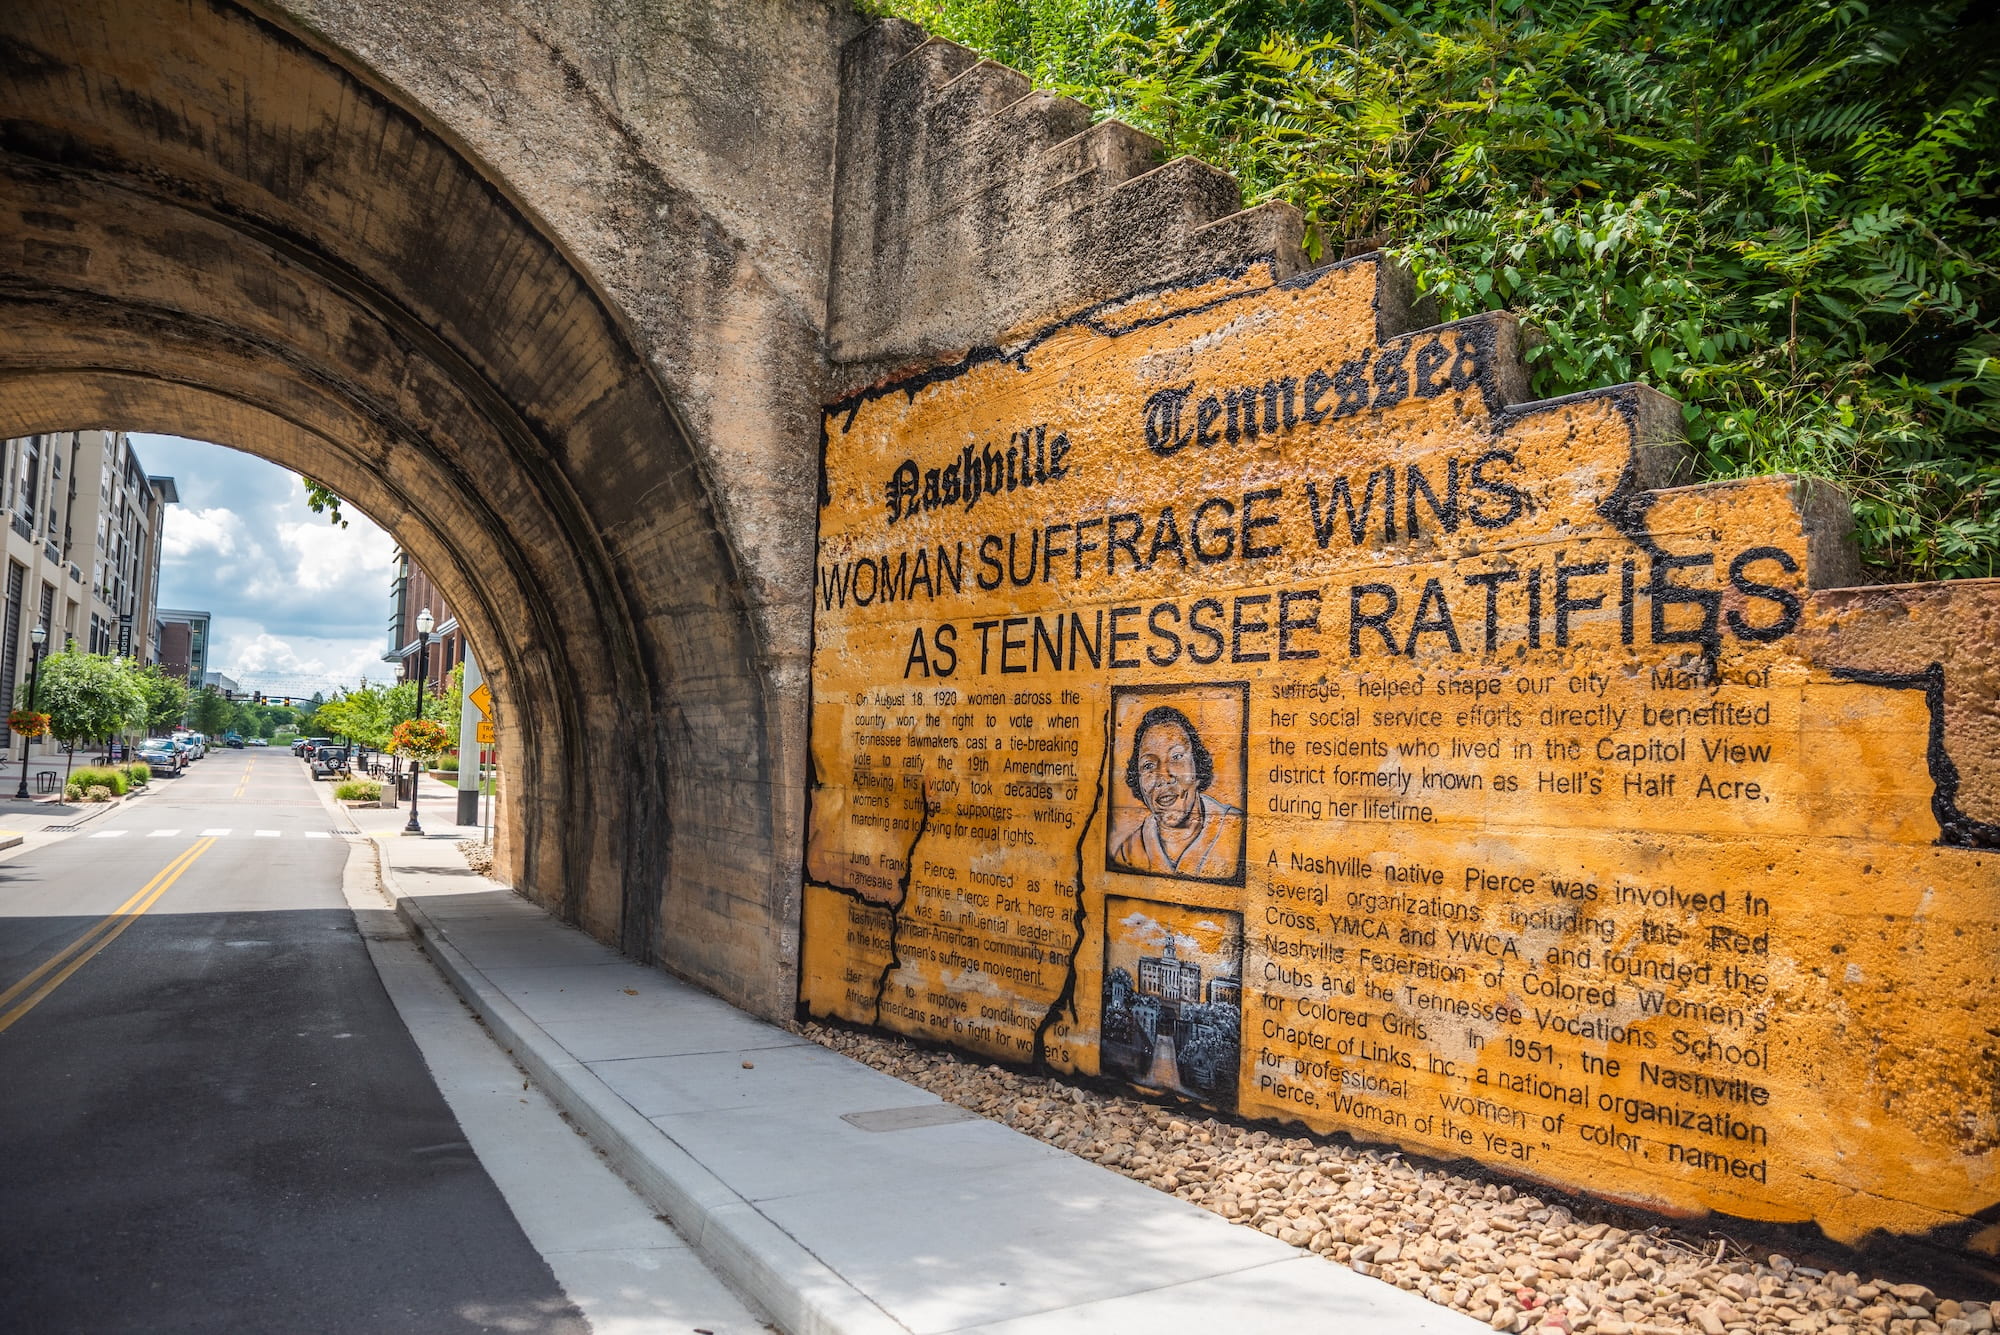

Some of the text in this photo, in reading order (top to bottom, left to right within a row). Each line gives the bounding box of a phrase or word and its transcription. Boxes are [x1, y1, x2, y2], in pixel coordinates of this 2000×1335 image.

[885, 326, 1484, 524] Nashville Tennessee
[821, 449, 1525, 611] WOMAN SUFFRAGE WINS
[904, 545, 1801, 679] AS TENNESSEE RATIFIES
[856, 689, 1080, 709] On August 1920 women across the
[1359, 678, 1425, 701] helped
[1437, 678, 1501, 700] shape
[1517, 676, 1555, 694] our
[1569, 673, 1610, 697] city
[1745, 665, 1773, 689] of
[855, 714, 1079, 731] country won the right to vote when
[1271, 702, 1770, 730] her social service efforts directly benefited
[853, 754, 1077, 776] vote to ratify the 19th Amendment.
[855, 732, 1078, 755] Tennessee lawmakers cast a tie-breaking
[1270, 738, 1771, 766] the residents who lived in the Capitol View
[853, 773, 1078, 800] Achieving victory took decades of
[1270, 765, 1769, 803] district formerly known as Hell's Half Acre,
[852, 794, 889, 808] women's
[957, 804, 1012, 820] supporters
[1269, 795, 1321, 819] during
[1328, 797, 1358, 816] her
[851, 813, 1037, 845] marching and for equal rights.
[849, 853, 1074, 898] Juno honored as the
[849, 873, 892, 890] namesake
[915, 880, 950, 899] Frankie
[957, 887, 989, 907] Pierce
[996, 894, 1021, 913] Park
[1028, 901, 1054, 918] here
[1267, 849, 1725, 913] A Nashville native Pierce was involved
[914, 904, 1071, 947] was an influential leader in
[1267, 882, 1328, 902] several
[1642, 919, 1683, 946] the
[1705, 925, 1769, 955] Red
[939, 950, 1044, 986] suffrage movement.
[983, 939, 1043, 964] community
[1265, 907, 1769, 994] Cross, YMCA and and founded the
[1265, 935, 1616, 1007] Nashville Federation of Colored
[906, 984, 1036, 1032] to improve conditions
[930, 1012, 1011, 1047] and to fight for
[1264, 963, 1768, 1070] Clubs and the Tennessee Vocations School
[1263, 991, 1286, 1011] for
[1297, 997, 1367, 1027] Colored
[1383, 1013, 1433, 1042] Girls.
[1505, 1037, 1563, 1070] 1951,
[1640, 1062, 1770, 1106] Nashville
[1263, 1019, 1766, 1146] Chapter of Links, Inc., a national organization
[1261, 1075, 1319, 1110] Pierce,
[1415, 1115, 1434, 1134] of
[1442, 1119, 1472, 1144] the
[1261, 1048, 1766, 1184] for professional women of color, named
